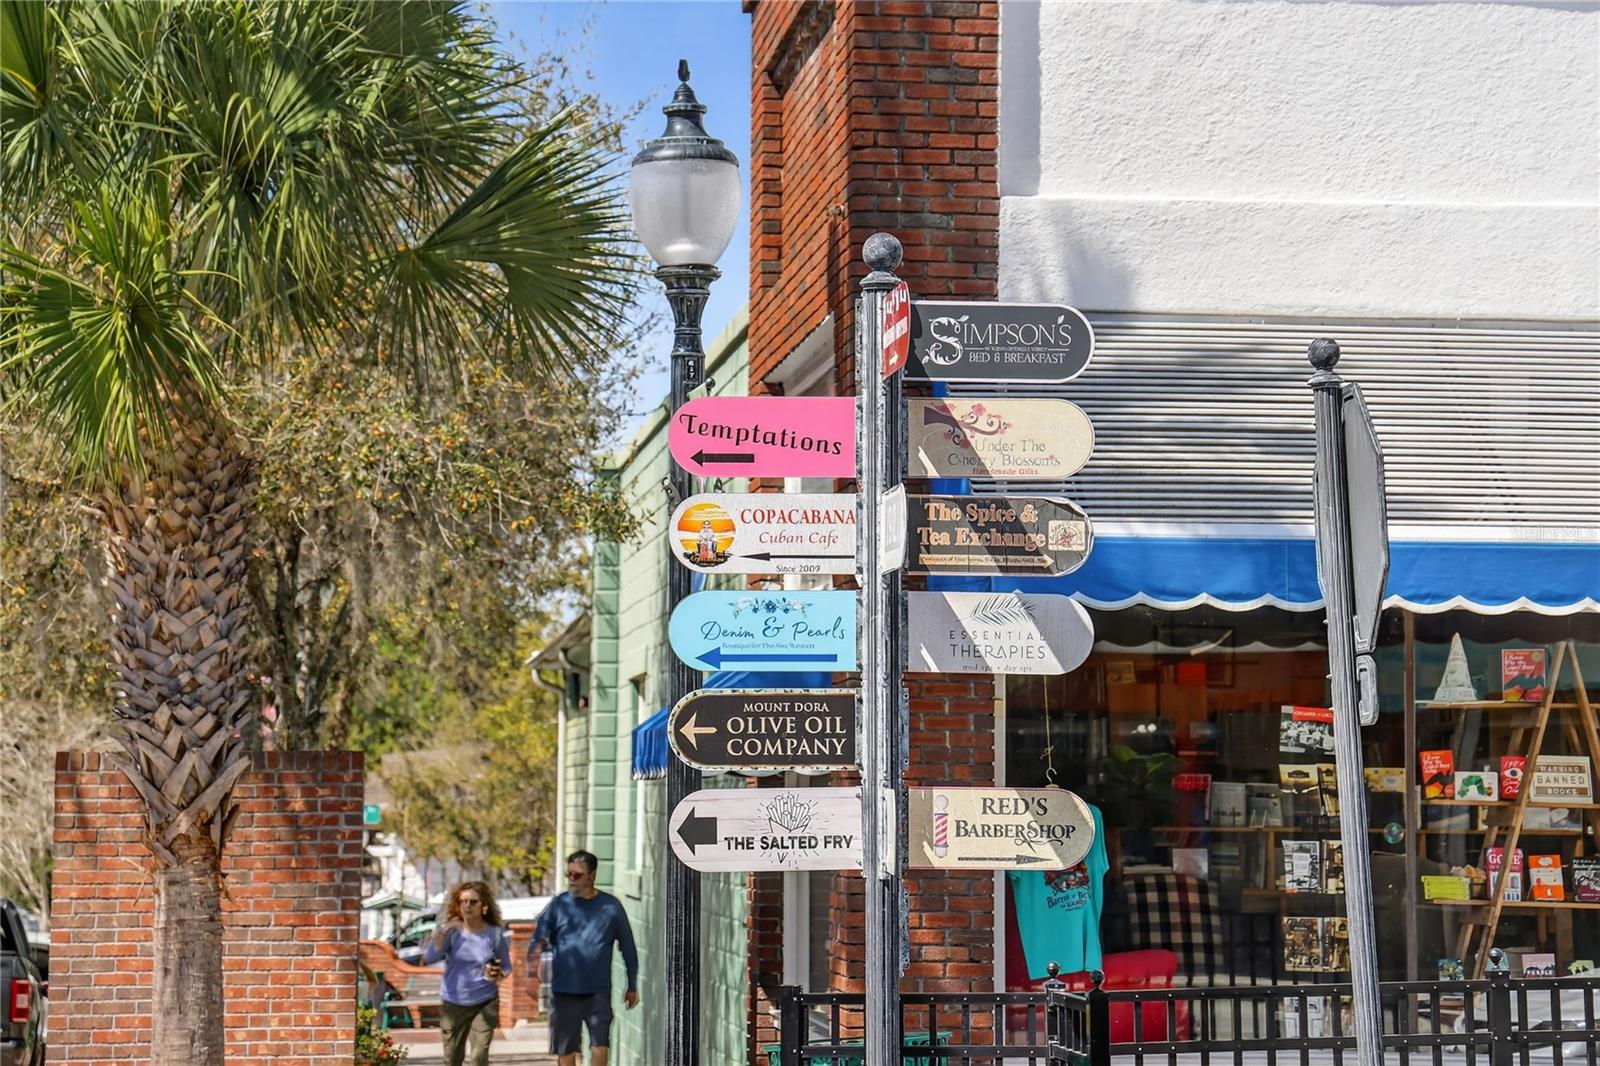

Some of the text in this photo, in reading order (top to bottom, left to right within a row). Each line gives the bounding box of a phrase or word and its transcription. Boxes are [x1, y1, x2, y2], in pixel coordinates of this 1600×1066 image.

[969, 352, 991, 363] BED
[1004, 352, 1066, 364] BREAKFAST
[679, 413, 842, 455] Temptations
[975, 439, 1047, 453] Under The
[1002, 453, 1061, 467] Blossoms
[740, 508, 856, 525] COPACABANA
[924, 502, 1038, 526] The Spice &
[759, 529, 839, 550] Cuban Cafe
[917, 527, 1046, 551] Tea Exchange
[776, 565, 796, 573] Since
[700, 616, 846, 641] Denim & Pearls
[949, 631, 1046, 641] ESSENTIAL
[950, 643, 1046, 660] THERAPIES
[743, 702, 830, 713] MOUNT DORA
[726, 716, 847, 734] OLIVE OIL
[726, 738, 847, 756] COMPANY
[1537, 775, 1585, 784] BANNED
[981, 796, 1048, 816] RED'S
[724, 835, 854, 850] THE SALTED FRY
[1488, 854, 1520, 865] GOE
